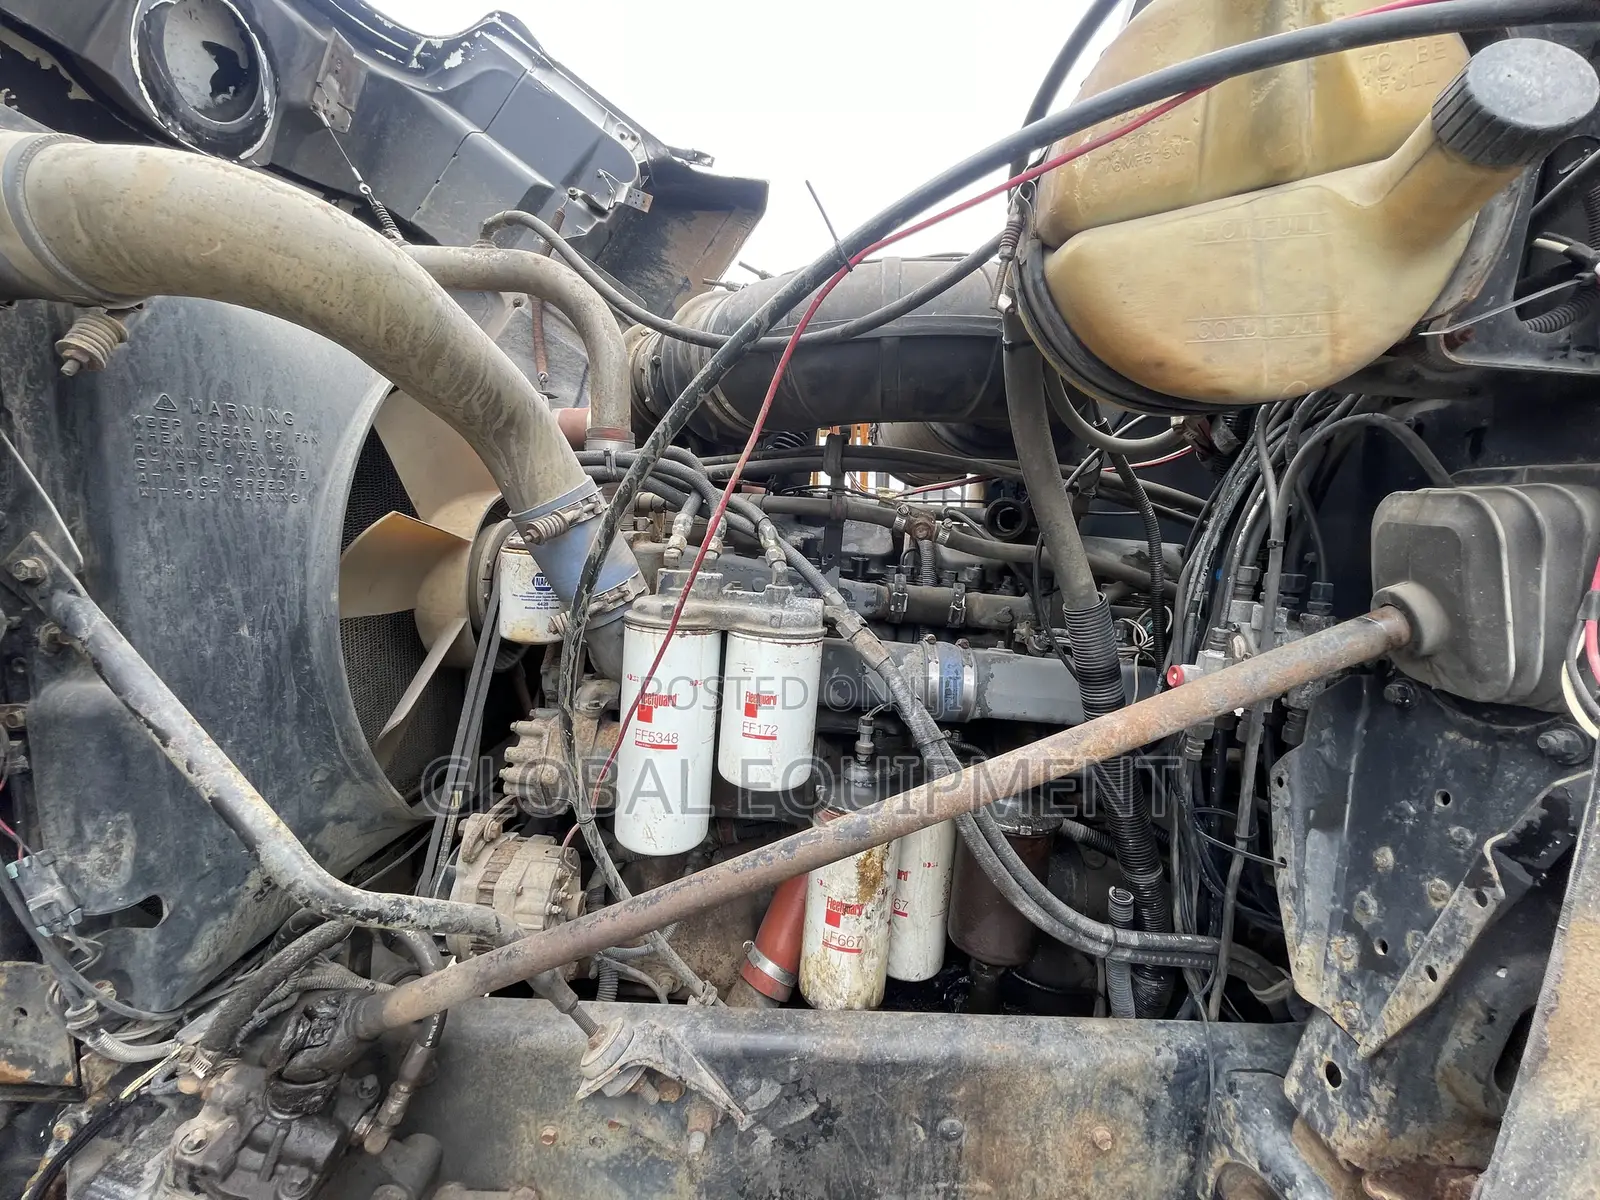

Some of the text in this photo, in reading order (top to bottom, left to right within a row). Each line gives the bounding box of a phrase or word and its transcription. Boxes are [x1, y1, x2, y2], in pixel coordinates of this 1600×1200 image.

[1416, 39, 1447, 63] BE
[189, 398, 295, 426] WARNING
[131, 413, 319, 445] KEEP CLEAR OF FAN
[134, 429, 284, 453] WHEN ENGINE IS
[135, 444, 302, 468] RUNNING FAN MAY
[135, 458, 307, 480] START TO ROTATE
[137, 472, 287, 491] AT HIGH SPEED
[138, 487, 219, 500] WITHOUT
[745, 690, 779, 707] Fleetguard
[635, 728, 679, 744] FF5348
[742, 721, 779, 736] FF172
[822, 927, 865, 948] LF667
